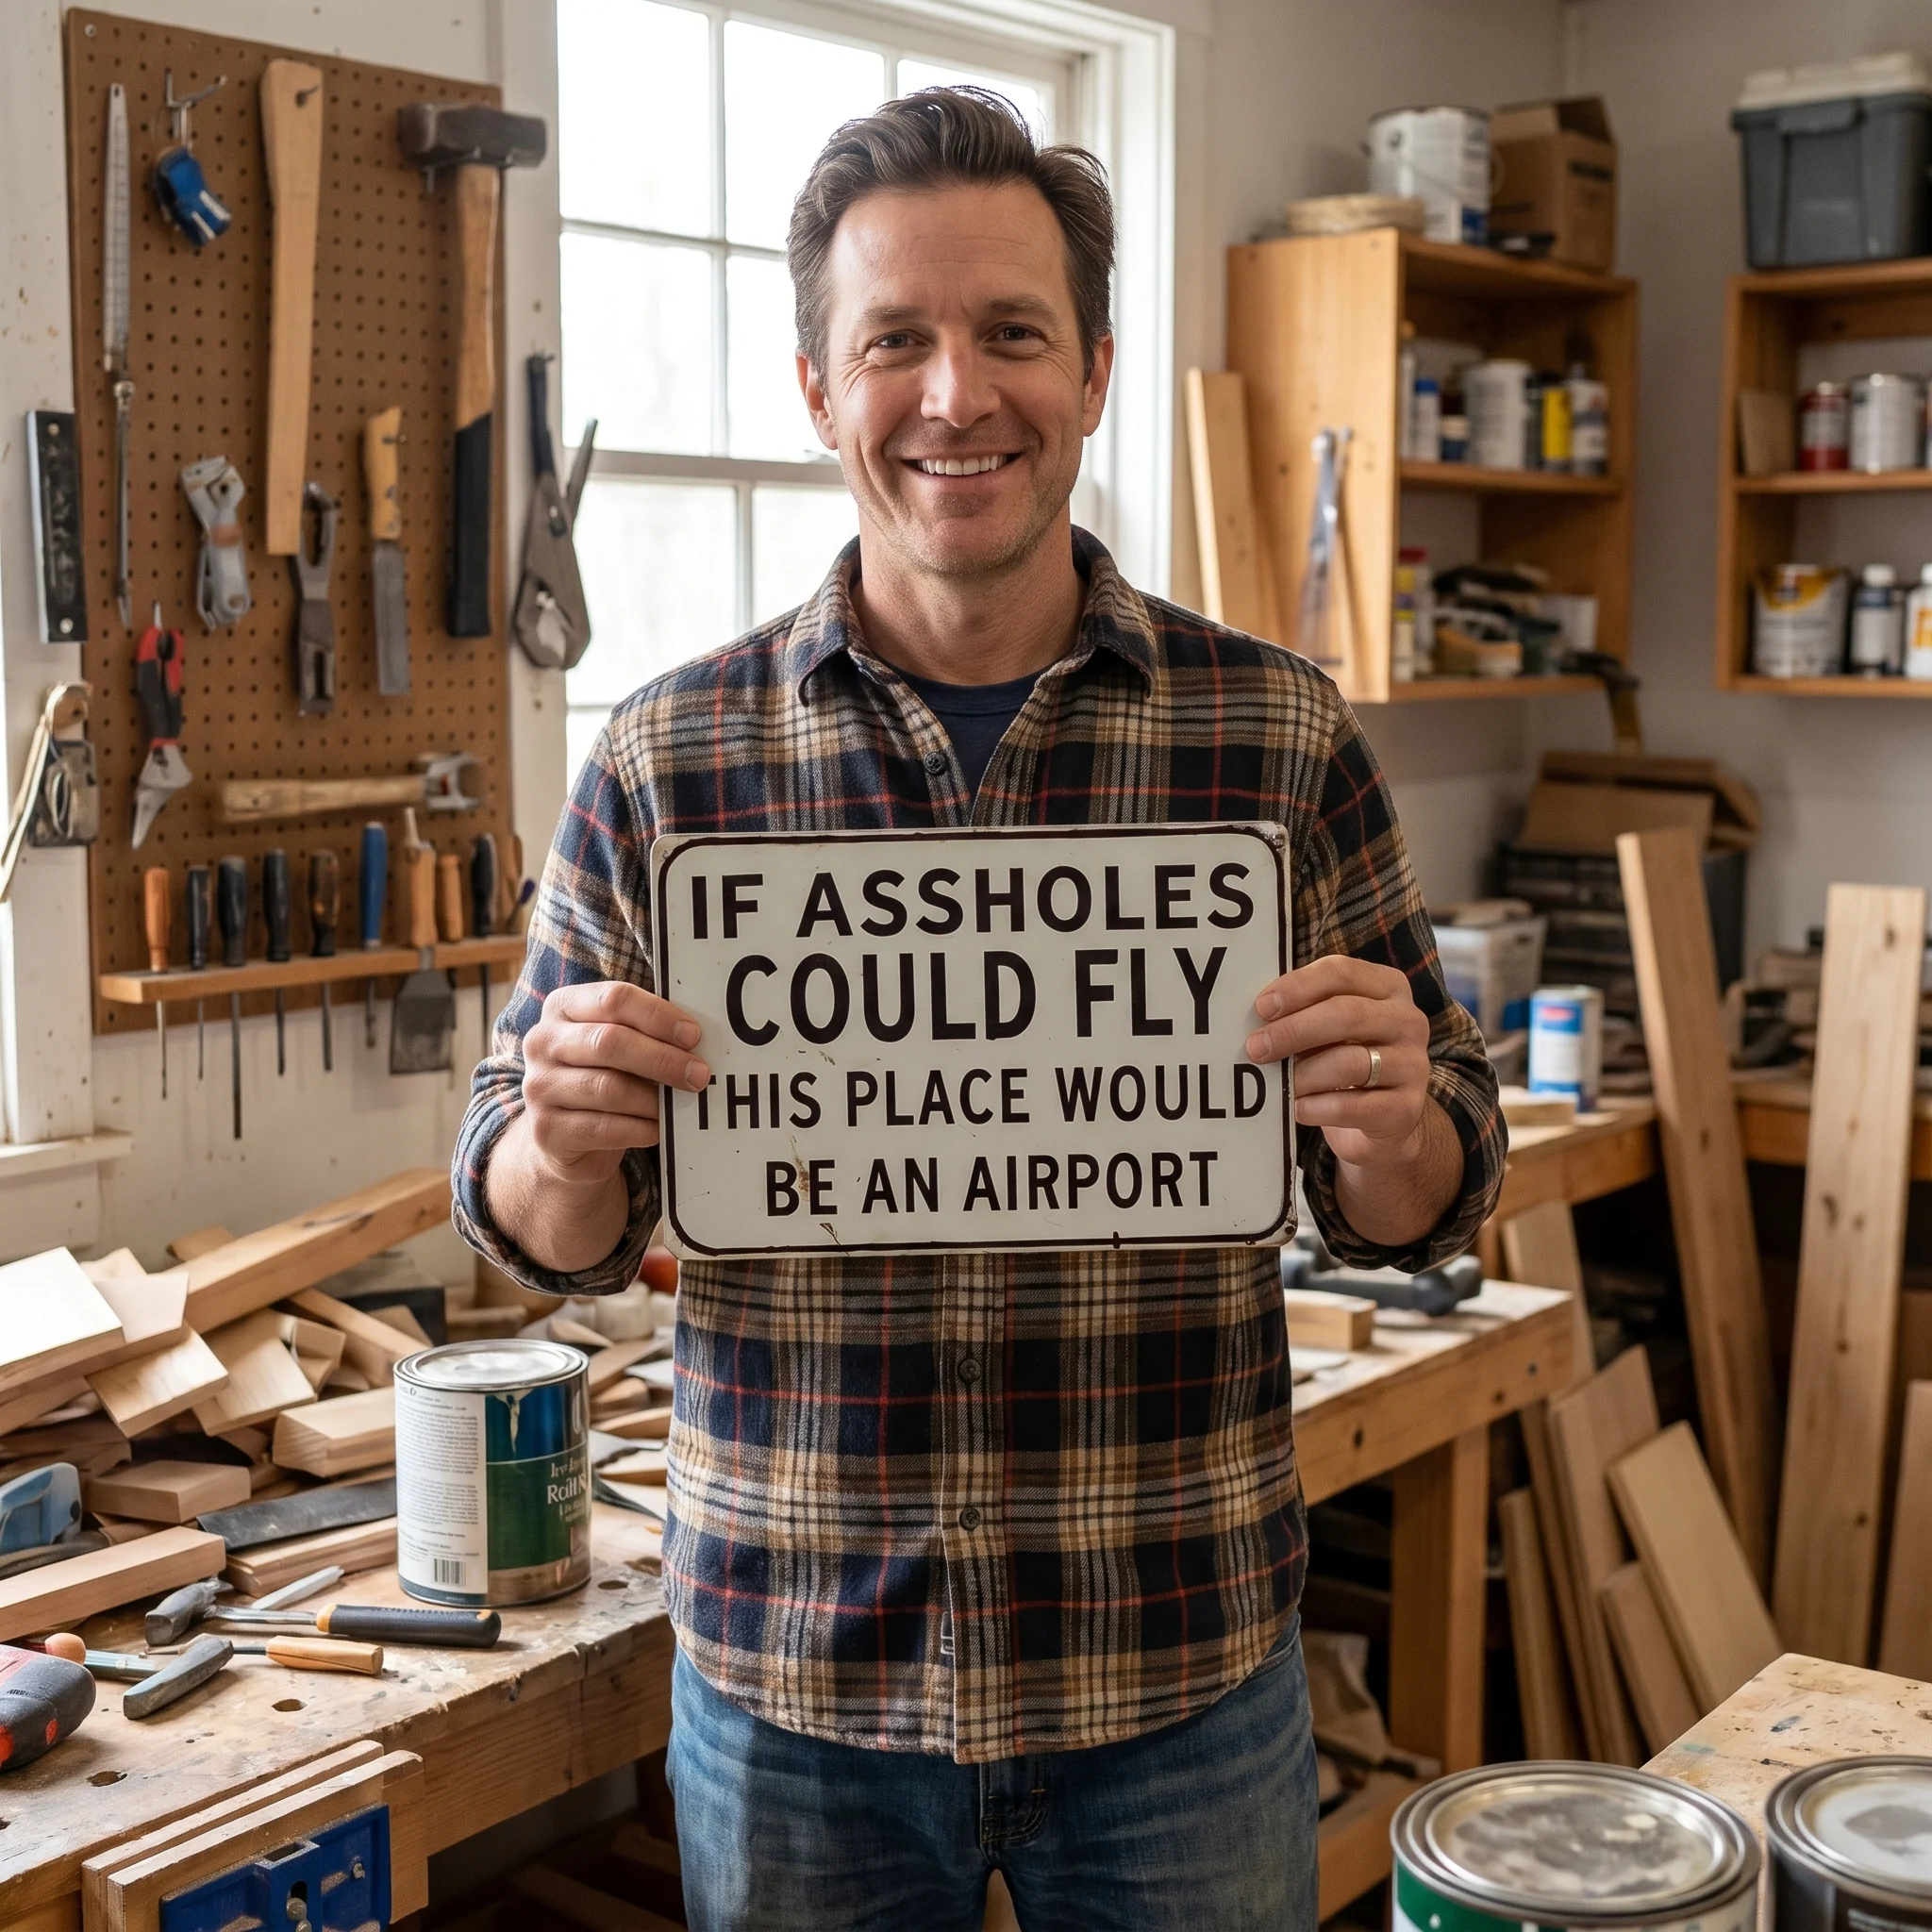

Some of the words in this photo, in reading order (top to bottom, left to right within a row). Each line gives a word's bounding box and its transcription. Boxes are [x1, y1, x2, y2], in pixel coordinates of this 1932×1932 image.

[691, 873, 764, 940] IF
[795, 862, 1255, 940] ASSHOLES
[725, 950, 1037, 1047] COULD
[1074, 946, 1228, 1038] FLY
[846, 1068, 1030, 1127] PLACE
[1054, 1062, 1267, 1123] WOULD
[766, 1158, 838, 1217] BE
[860, 1157, 939, 1214] AN
[962, 1151, 1219, 1212] AIRPORT
